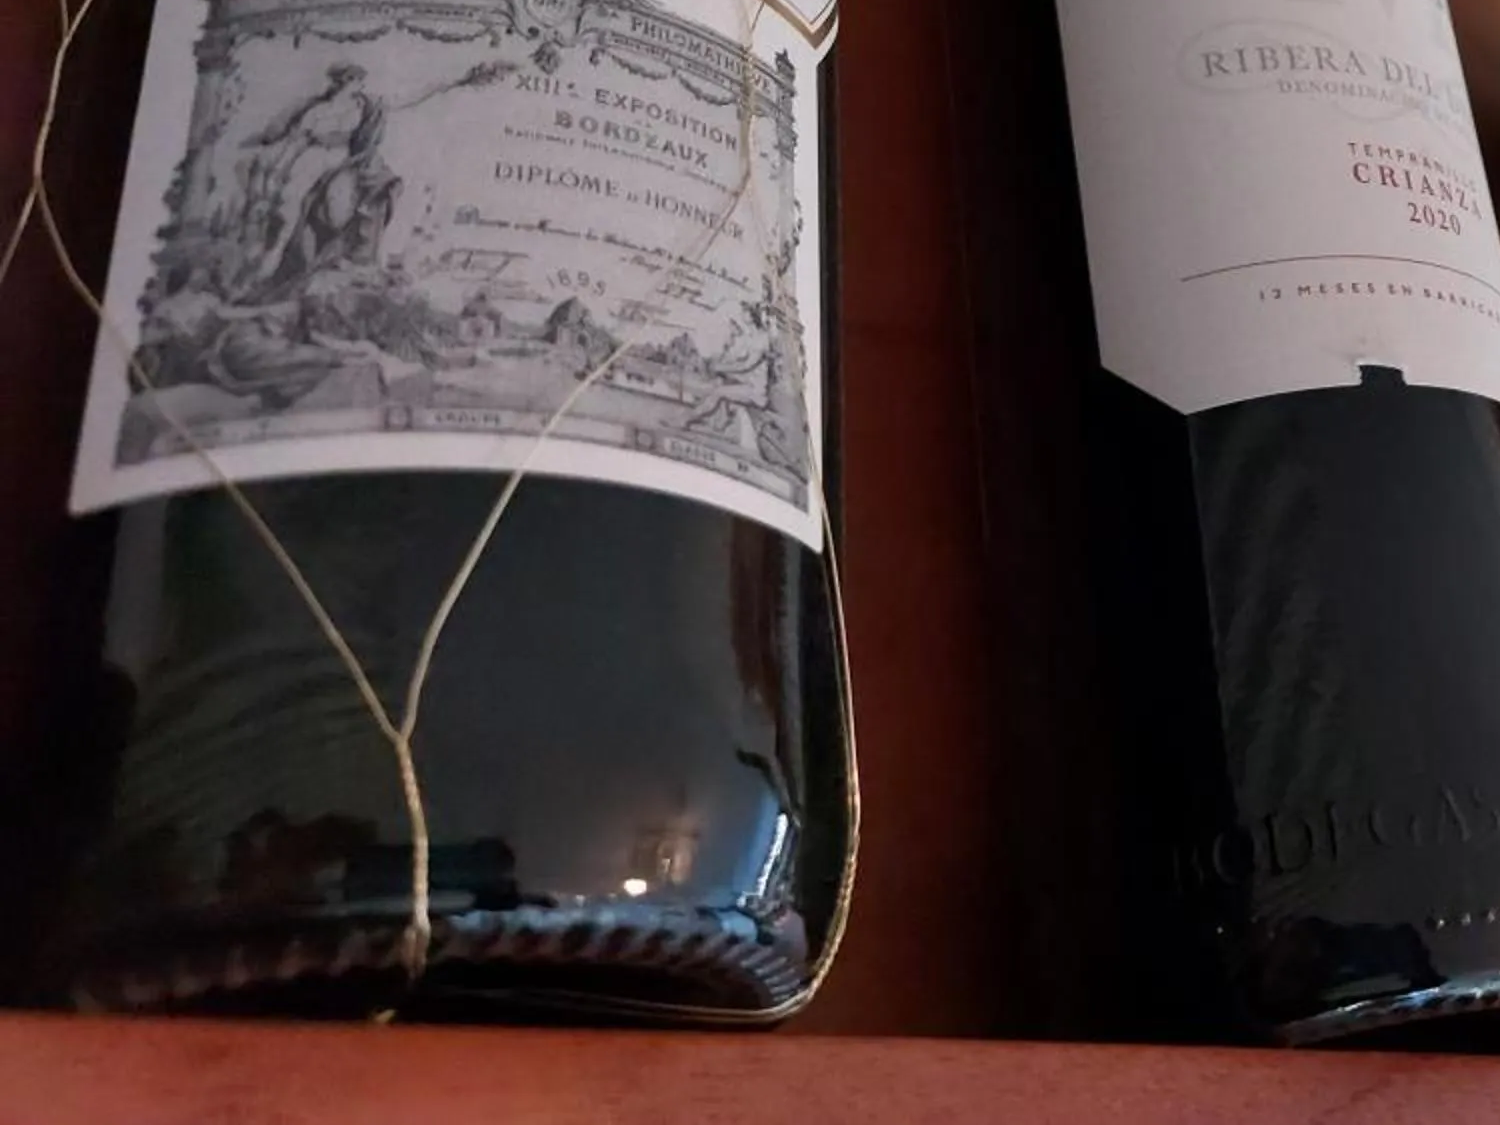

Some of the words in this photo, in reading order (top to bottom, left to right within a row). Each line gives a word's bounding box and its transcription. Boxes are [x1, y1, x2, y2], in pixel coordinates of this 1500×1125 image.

[631, 15, 772, 94] PHILOMATHIUE
[1202, 45, 1367, 78] RIBERA
[555, 110, 709, 169] BORDEAUX
[595, 88, 738, 151] EXPOSITION
[1353, 162, 1483, 220] CRIANZA
[1408, 202, 1461, 235] 2020
[1297, 282, 1375, 296] MESES
[1389, 283, 1412, 296] EN
